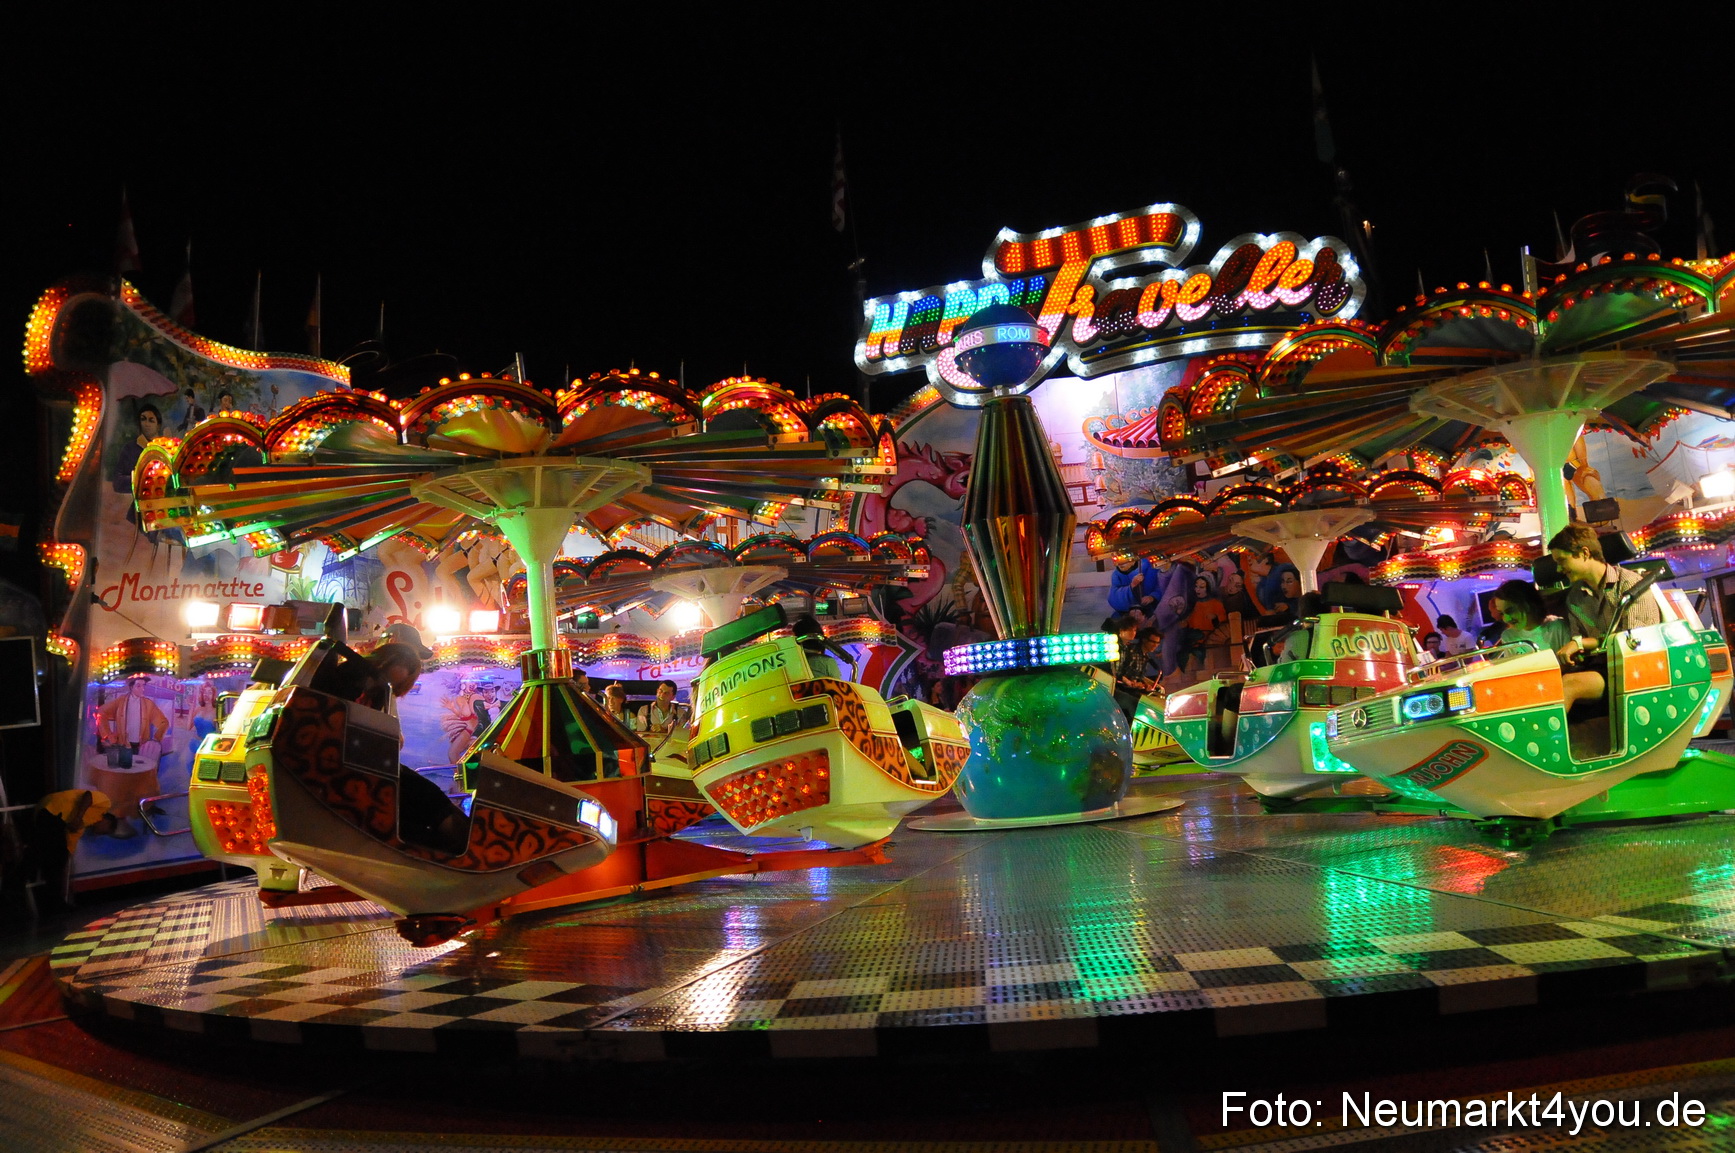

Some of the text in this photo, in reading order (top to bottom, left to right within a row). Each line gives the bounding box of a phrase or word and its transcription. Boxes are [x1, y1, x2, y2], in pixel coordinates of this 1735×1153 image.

[955, 330, 984, 350] ARIS
[997, 326, 1031, 340] ROM
[99, 572, 265, 612] Montmartre
[700, 651, 786, 713] CHAMPIONS
